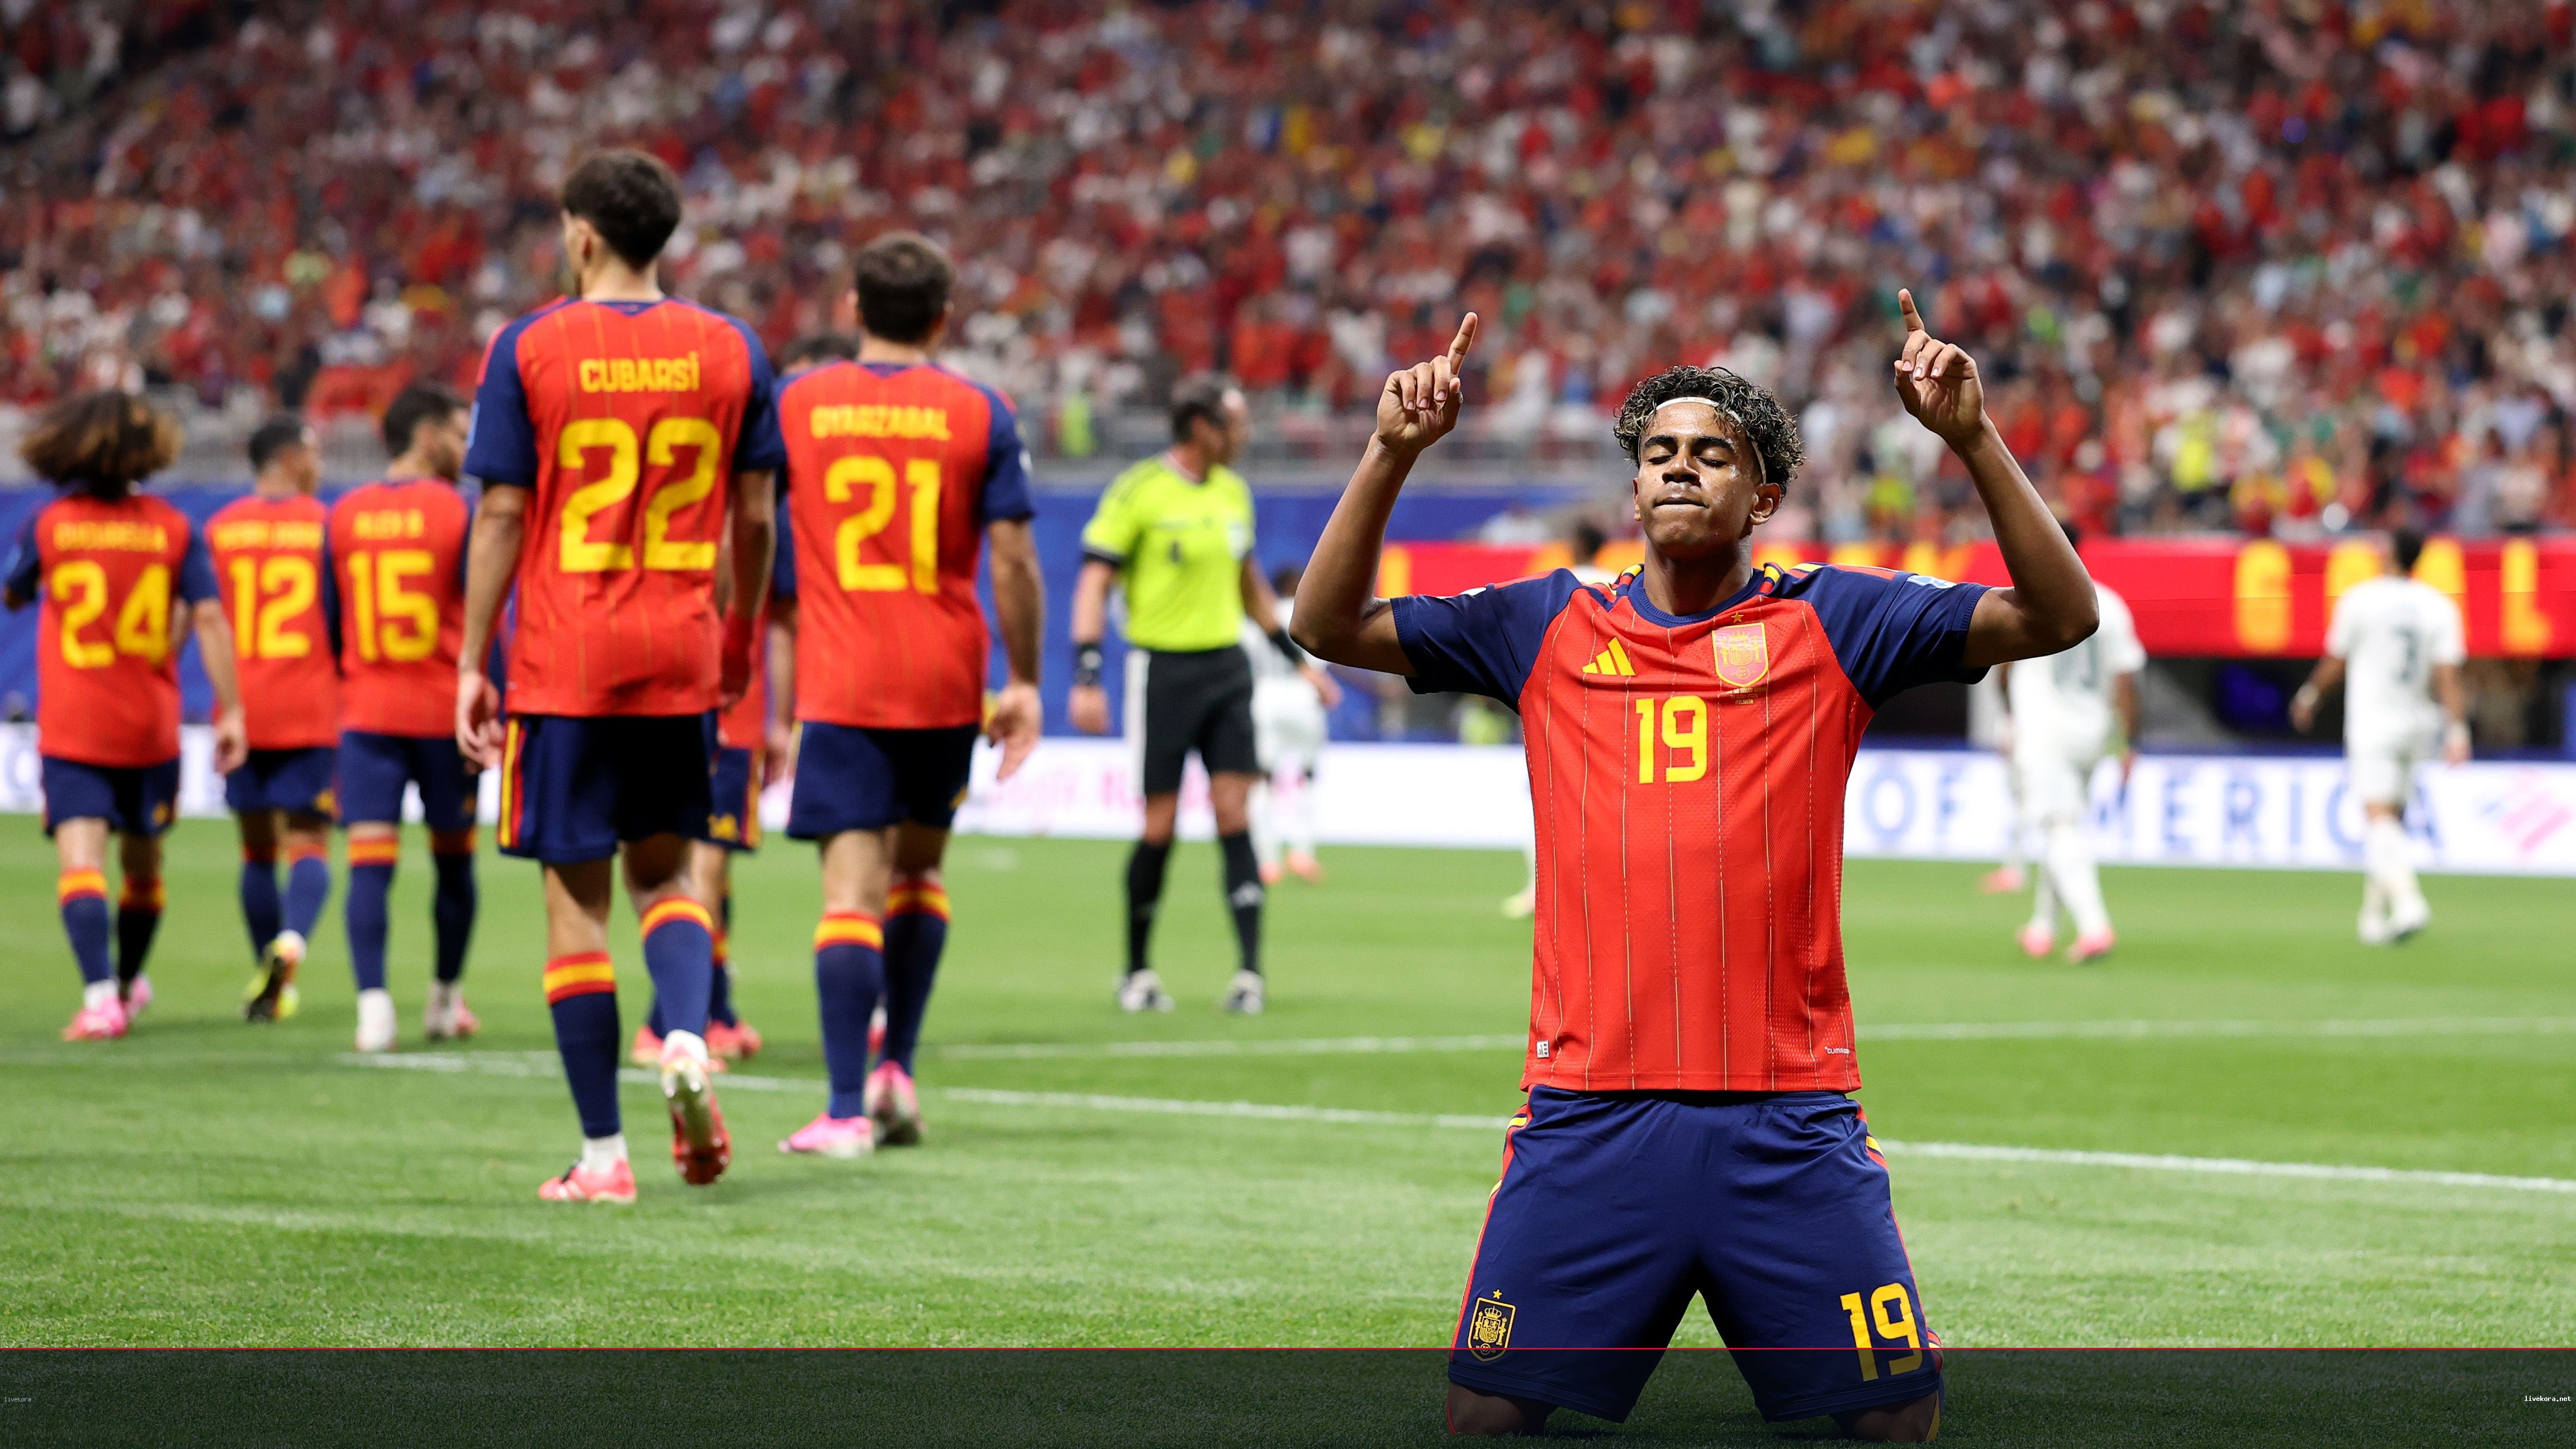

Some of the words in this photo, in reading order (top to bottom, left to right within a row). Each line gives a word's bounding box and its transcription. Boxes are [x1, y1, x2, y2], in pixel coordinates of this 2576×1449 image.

[579, 350, 700, 393] CUBARSÍ
[559, 417, 721, 573] 22
[825, 455, 942, 595] 21
[52, 559, 169, 668] 24
[229, 555, 317, 659] 12
[347, 550, 440, 662] 15
[1635, 696, 1707, 784] 19
[1862, 768, 1961, 842] OF
[2009, 774, 2444, 849] MERICA
[1840, 1282, 1923, 1382] 19
